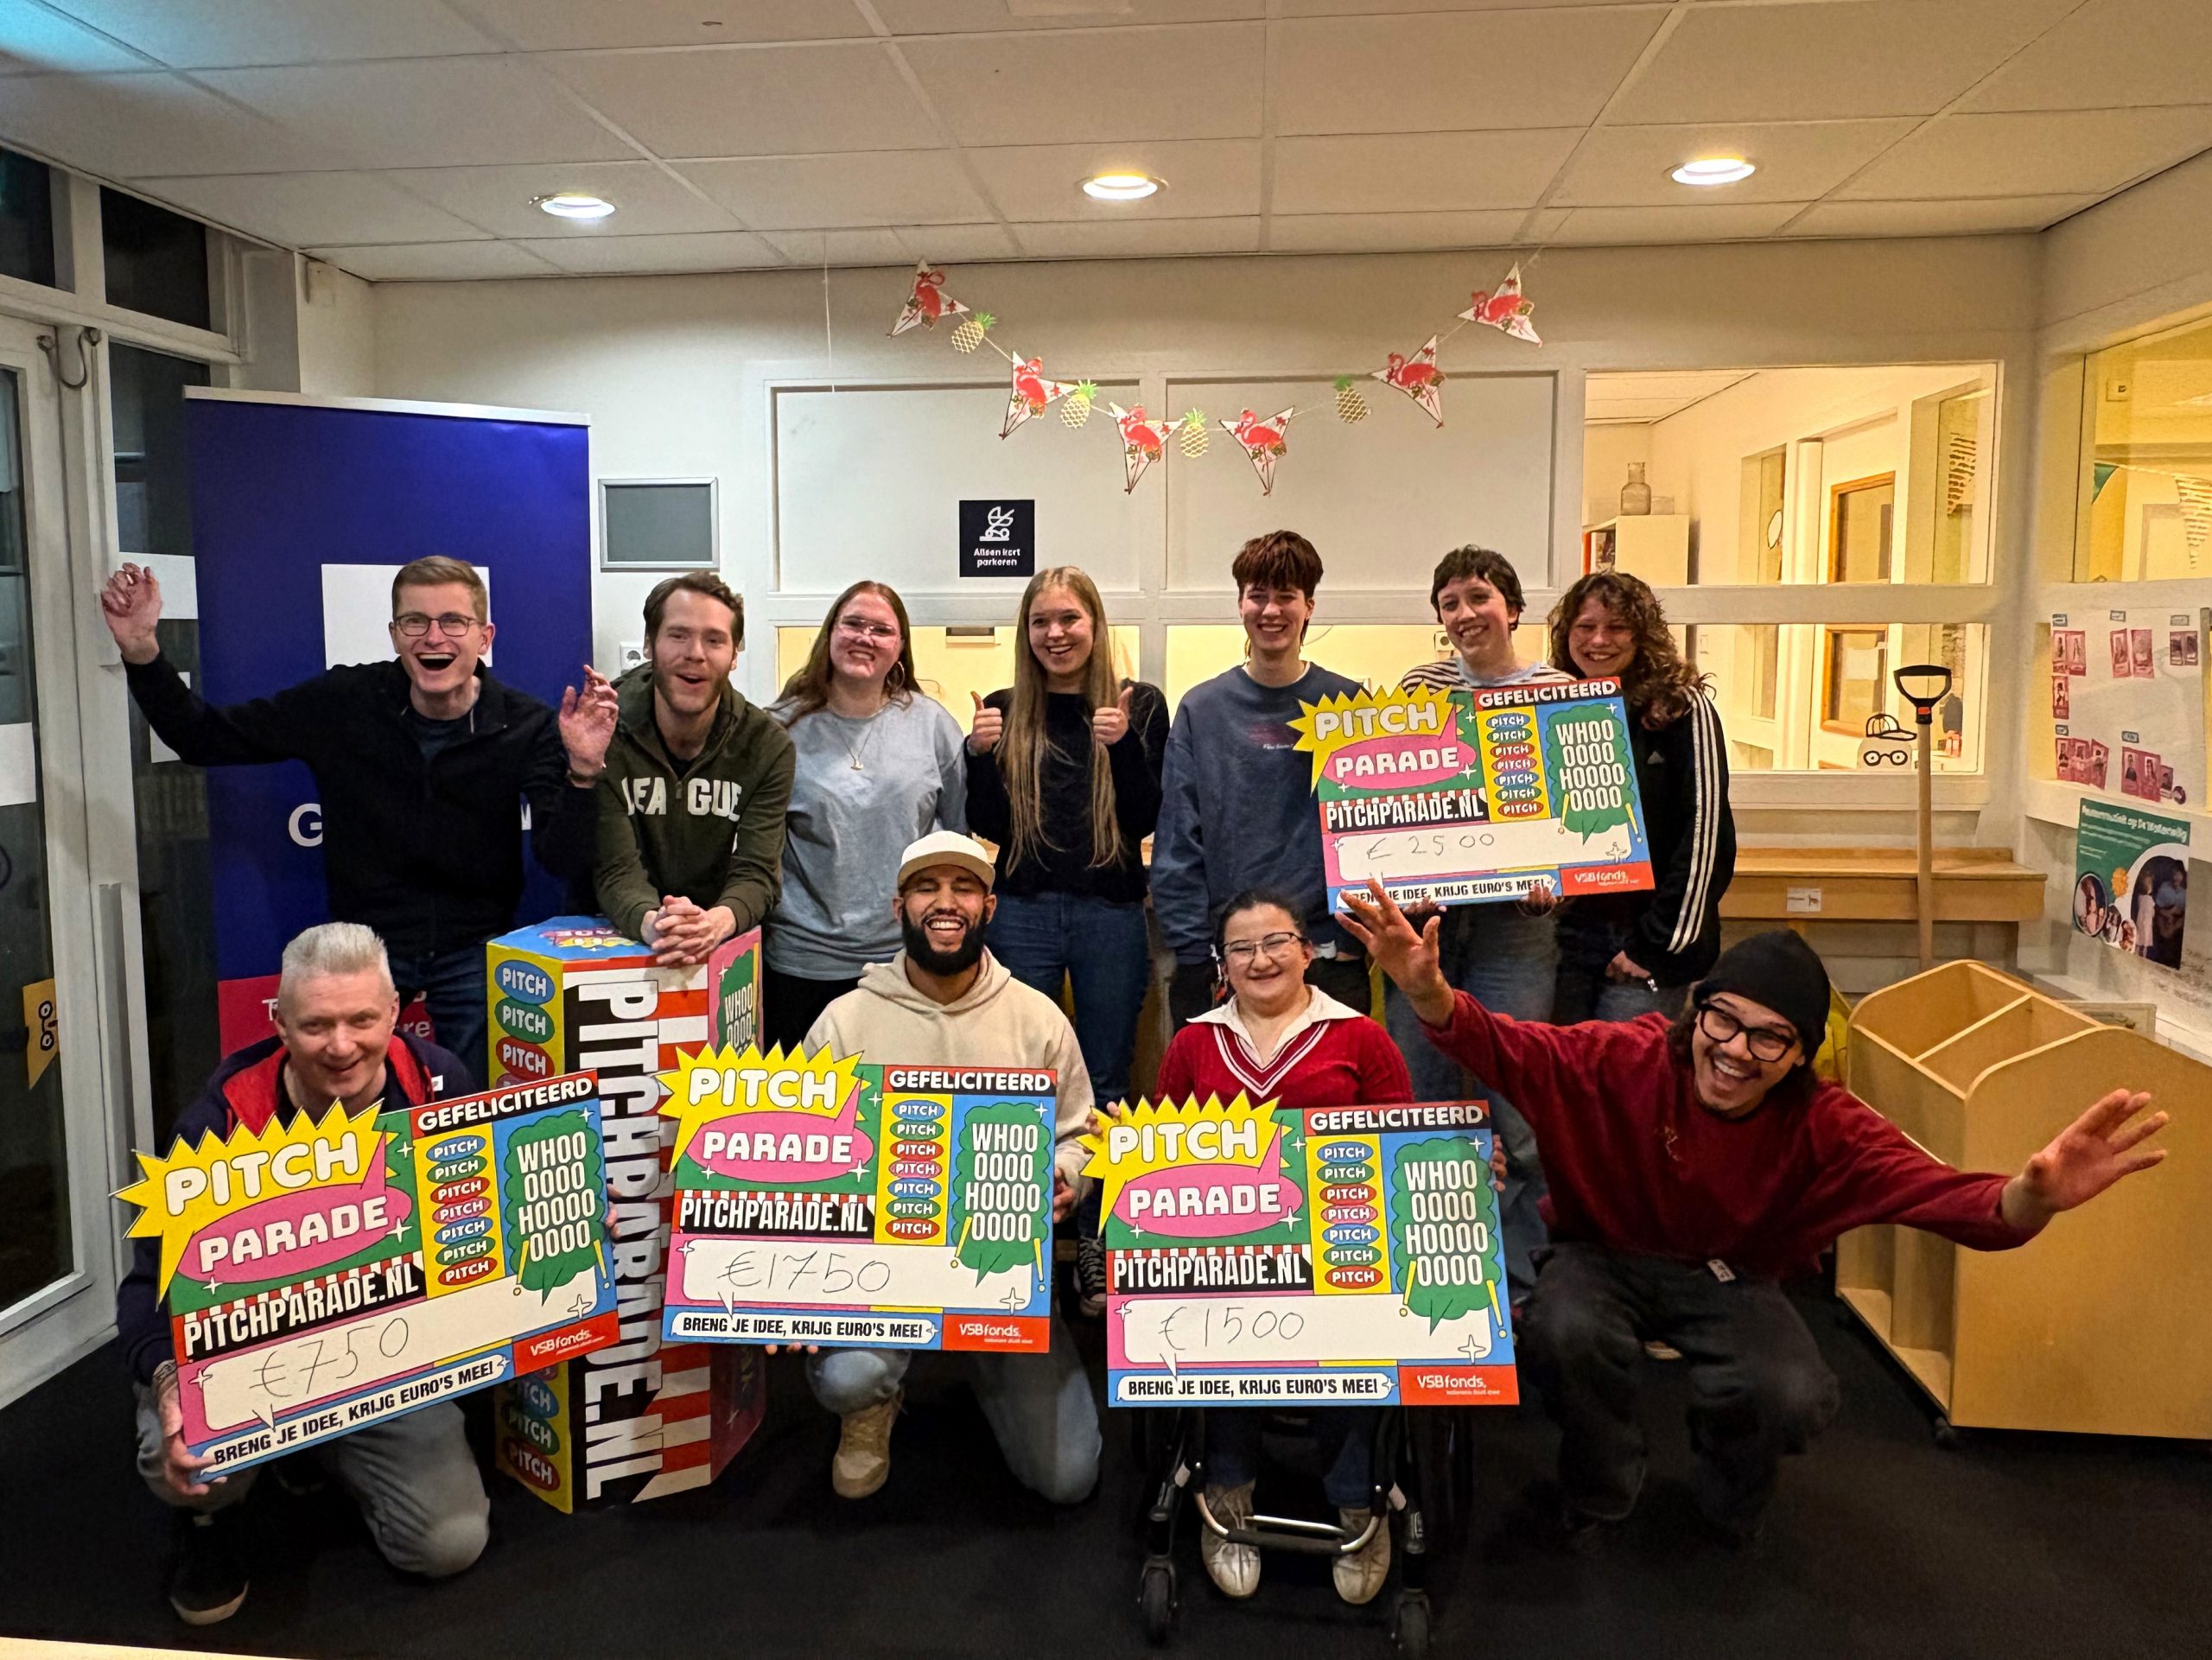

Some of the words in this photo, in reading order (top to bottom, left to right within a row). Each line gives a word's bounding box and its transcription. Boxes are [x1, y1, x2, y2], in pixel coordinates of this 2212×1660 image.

[1479, 682, 1617, 708] GEFELICITEERD
[1315, 701, 1437, 741] PITCH
[1491, 716, 1524, 727] PITCH
[1492, 730, 1525, 741] PITCH
[1335, 747, 1459, 778] PARADE
[1495, 745, 1529, 755] PITCH
[1497, 760, 1530, 770] PITCH
[1499, 773, 1533, 785] PITCH
[1502, 788, 1535, 799] PITCH
[1326, 797, 1484, 830] PITCHPARADE.NL
[1503, 804, 1537, 814] PITCH
[1434, 885, 1469, 898] KRIJG
[1472, 881, 1512, 894] EURO'S
[502, 968, 547, 997] PITCH
[502, 1005, 547, 1035] PITCH
[502, 1044, 547, 1075] PITCH
[689, 1067, 837, 1110] PITCH
[889, 1071, 1051, 1091] GEFELICITEERD
[417, 1077, 594, 1131] GEFELICITEERD
[899, 1104, 938, 1117] PITCH
[897, 1123, 937, 1136] PITCH
[1310, 1105, 1484, 1131] GEFELICITEERD
[434, 1139, 477, 1158] PITCH
[702, 1131, 853, 1163] PARADE
[896, 1142, 936, 1156] PITCH
[972, 1123, 1039, 1153] WHOO
[1109, 1118, 1258, 1165] PITCH
[517, 1130, 588, 1173] WHOO
[1324, 1146, 1366, 1160] PITCH
[164, 1129, 360, 1217] PITCH
[435, 1159, 479, 1180] PITCH
[895, 1162, 937, 1176] PITCH
[974, 1154, 1033, 1182] OOOO
[1323, 1165, 1366, 1180] PITCH
[1405, 1161, 1478, 1192] WHOO
[438, 1180, 482, 1200] PITCH
[524, 1165, 586, 1203] OOOO
[893, 1182, 934, 1195] PITCH
[965, 1182, 1040, 1212] HOOOO
[1325, 1186, 1370, 1200] PITCH
[440, 1199, 484, 1220] PITCH
[518, 1189, 596, 1236] HOOOO
[679, 1195, 868, 1232] PITCHPARADE.NL
[893, 1201, 932, 1215] PITCH
[1129, 1184, 1281, 1218] PARADE
[1326, 1207, 1370, 1221] PITCH
[1411, 1193, 1478, 1223] OOOO
[199, 1195, 389, 1274] PARADE
[442, 1220, 486, 1241] PITCH
[891, 1221, 932, 1235] PITCH
[971, 1212, 1032, 1243] OOOO
[1329, 1228, 1372, 1242] PITCH
[1405, 1223, 1489, 1256] HOOOO
[444, 1240, 486, 1262] PITCH
[530, 1220, 591, 1262] OOOO
[1331, 1249, 1374, 1263] PITCH
[446, 1260, 489, 1282] PITCH
[717, 1250, 891, 1294] €1750
[1113, 1252, 1307, 1288] PITCHPARADE.NL
[1332, 1269, 1375, 1284] PITCH
[1415, 1255, 1484, 1287] OOOO
[182, 1259, 420, 1358] PITCHPARADE.NL
[683, 1318, 728, 1332] BRENG
[732, 1319, 749, 1333] JE
[753, 1319, 787, 1337] IDEE,
[792, 1320, 832, 1336] KRIJG
[837, 1322, 885, 1338] EURO'S
[1158, 1306, 1305, 1352] €1500
[249, 1317, 410, 1398] €750
[1128, 1380, 1174, 1396] BRENG
[1177, 1380, 1195, 1396] JE
[1199, 1380, 1235, 1397] IDEE,
[1239, 1379, 1282, 1396] KRIJG
[1286, 1379, 1338, 1395] EURO'S
[214, 1434, 271, 1466] BRENG
[276, 1423, 297, 1448] JE
[302, 1412, 344, 1440] IDEE,
[348, 1391, 397, 1421] KRIJG
[400, 1373, 454, 1408] EURO'S
